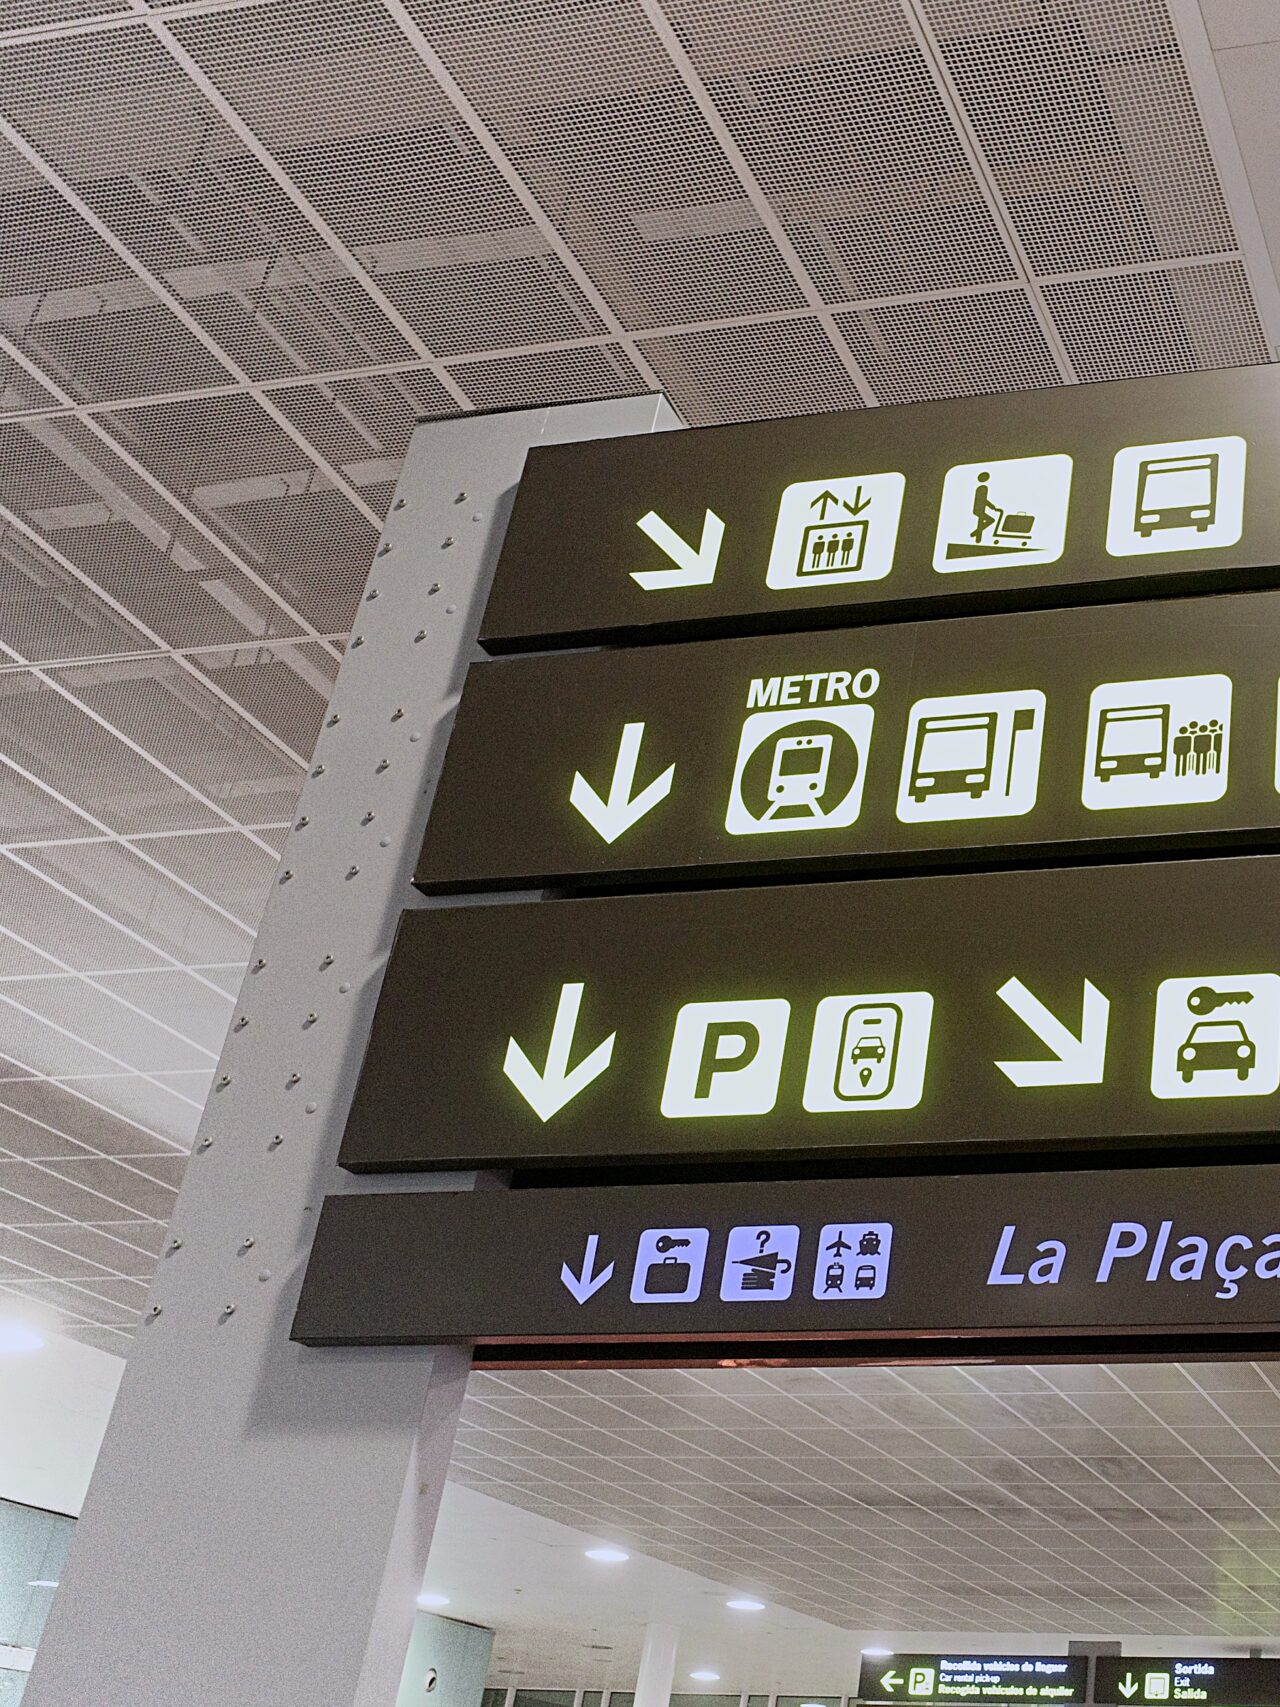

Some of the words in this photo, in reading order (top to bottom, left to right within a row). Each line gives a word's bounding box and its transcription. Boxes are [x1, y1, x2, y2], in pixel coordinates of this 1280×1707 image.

[746, 668, 880, 709] METRO
[694, 1020, 761, 1099] P
[986, 1225, 1065, 1285] La
[1174, 1662, 1215, 1675] Sortida
[939, 1673, 953, 1682] Car
[953, 1673, 974, 1682] rental
[1174, 1676, 1190, 1687] Exit
[1173, 1688, 1207, 1699] Salida
